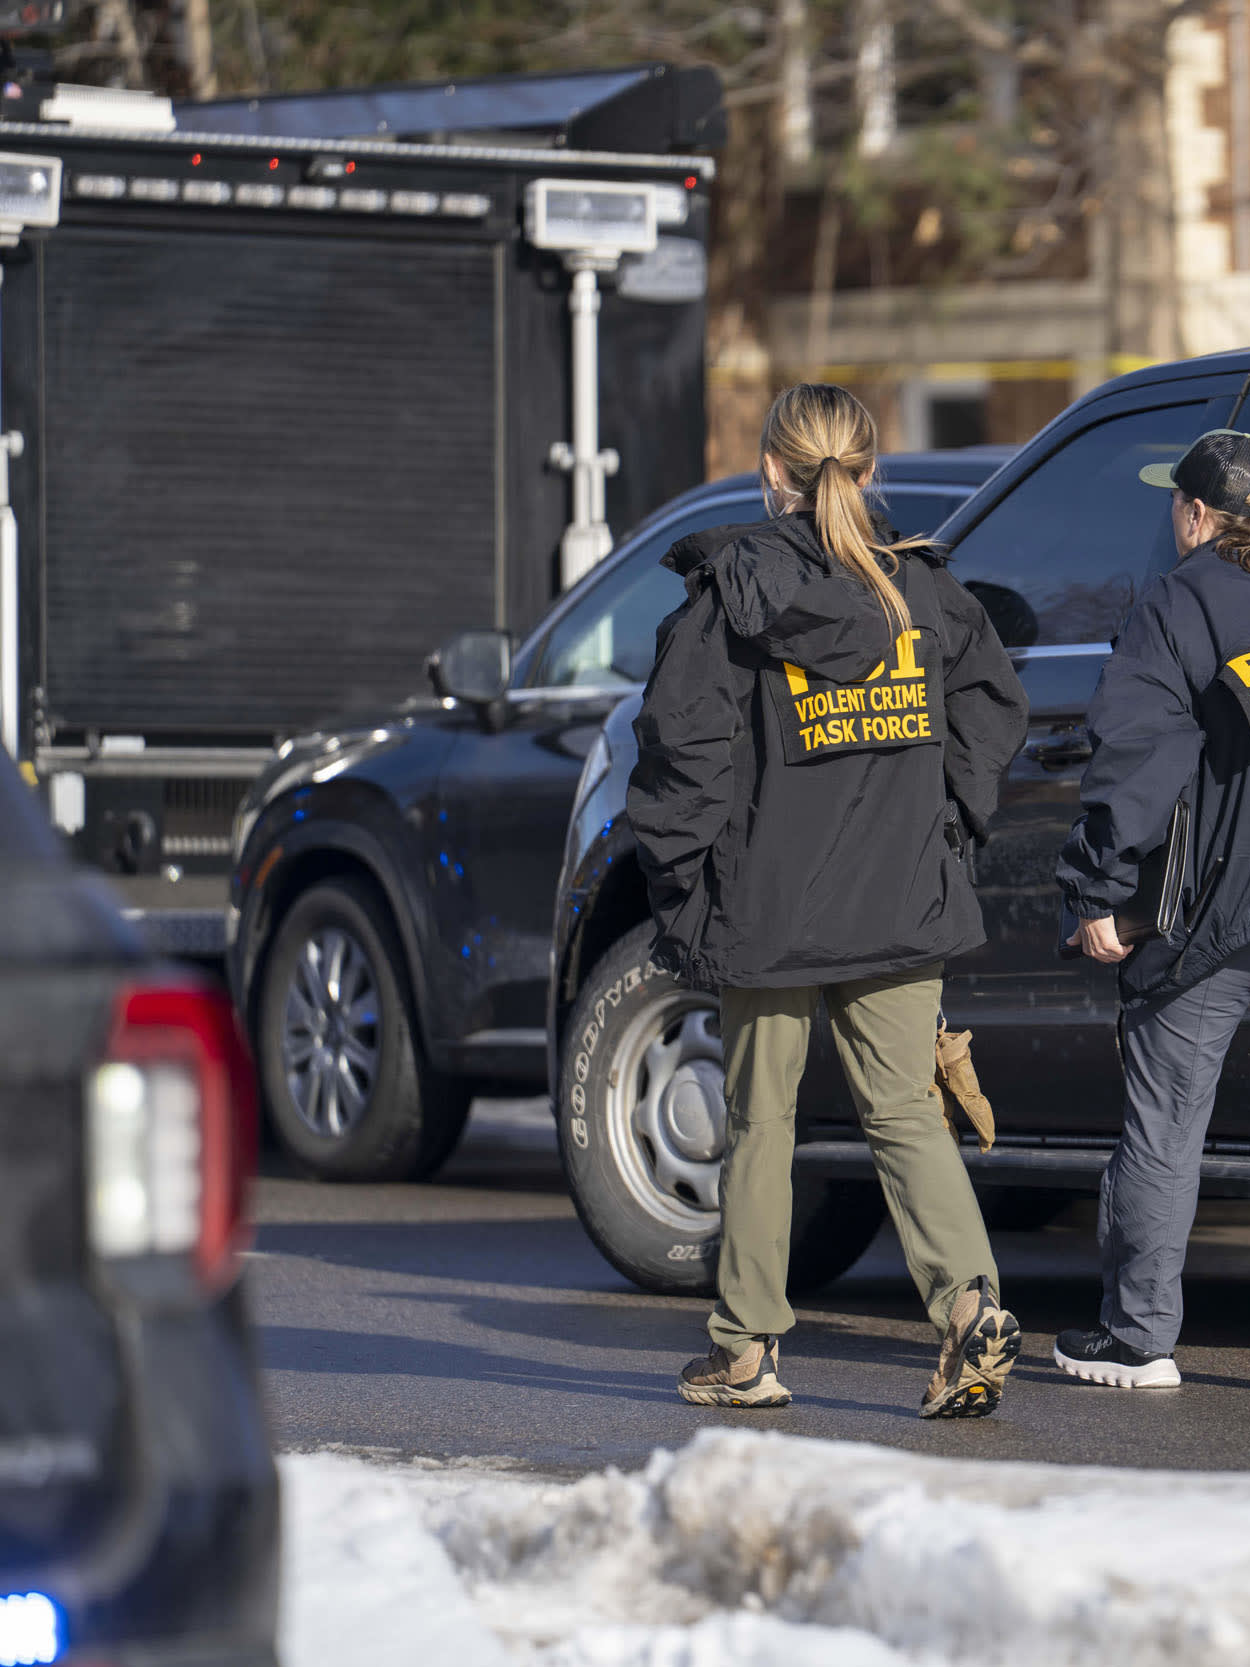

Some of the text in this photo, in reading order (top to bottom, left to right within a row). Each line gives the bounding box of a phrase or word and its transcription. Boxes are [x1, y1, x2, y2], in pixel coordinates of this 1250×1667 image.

[794, 683, 927, 723] VIOLENT CRIME
[799, 713, 931, 751] TASK FORCE
[571, 960, 668, 1148] GOODYEA
